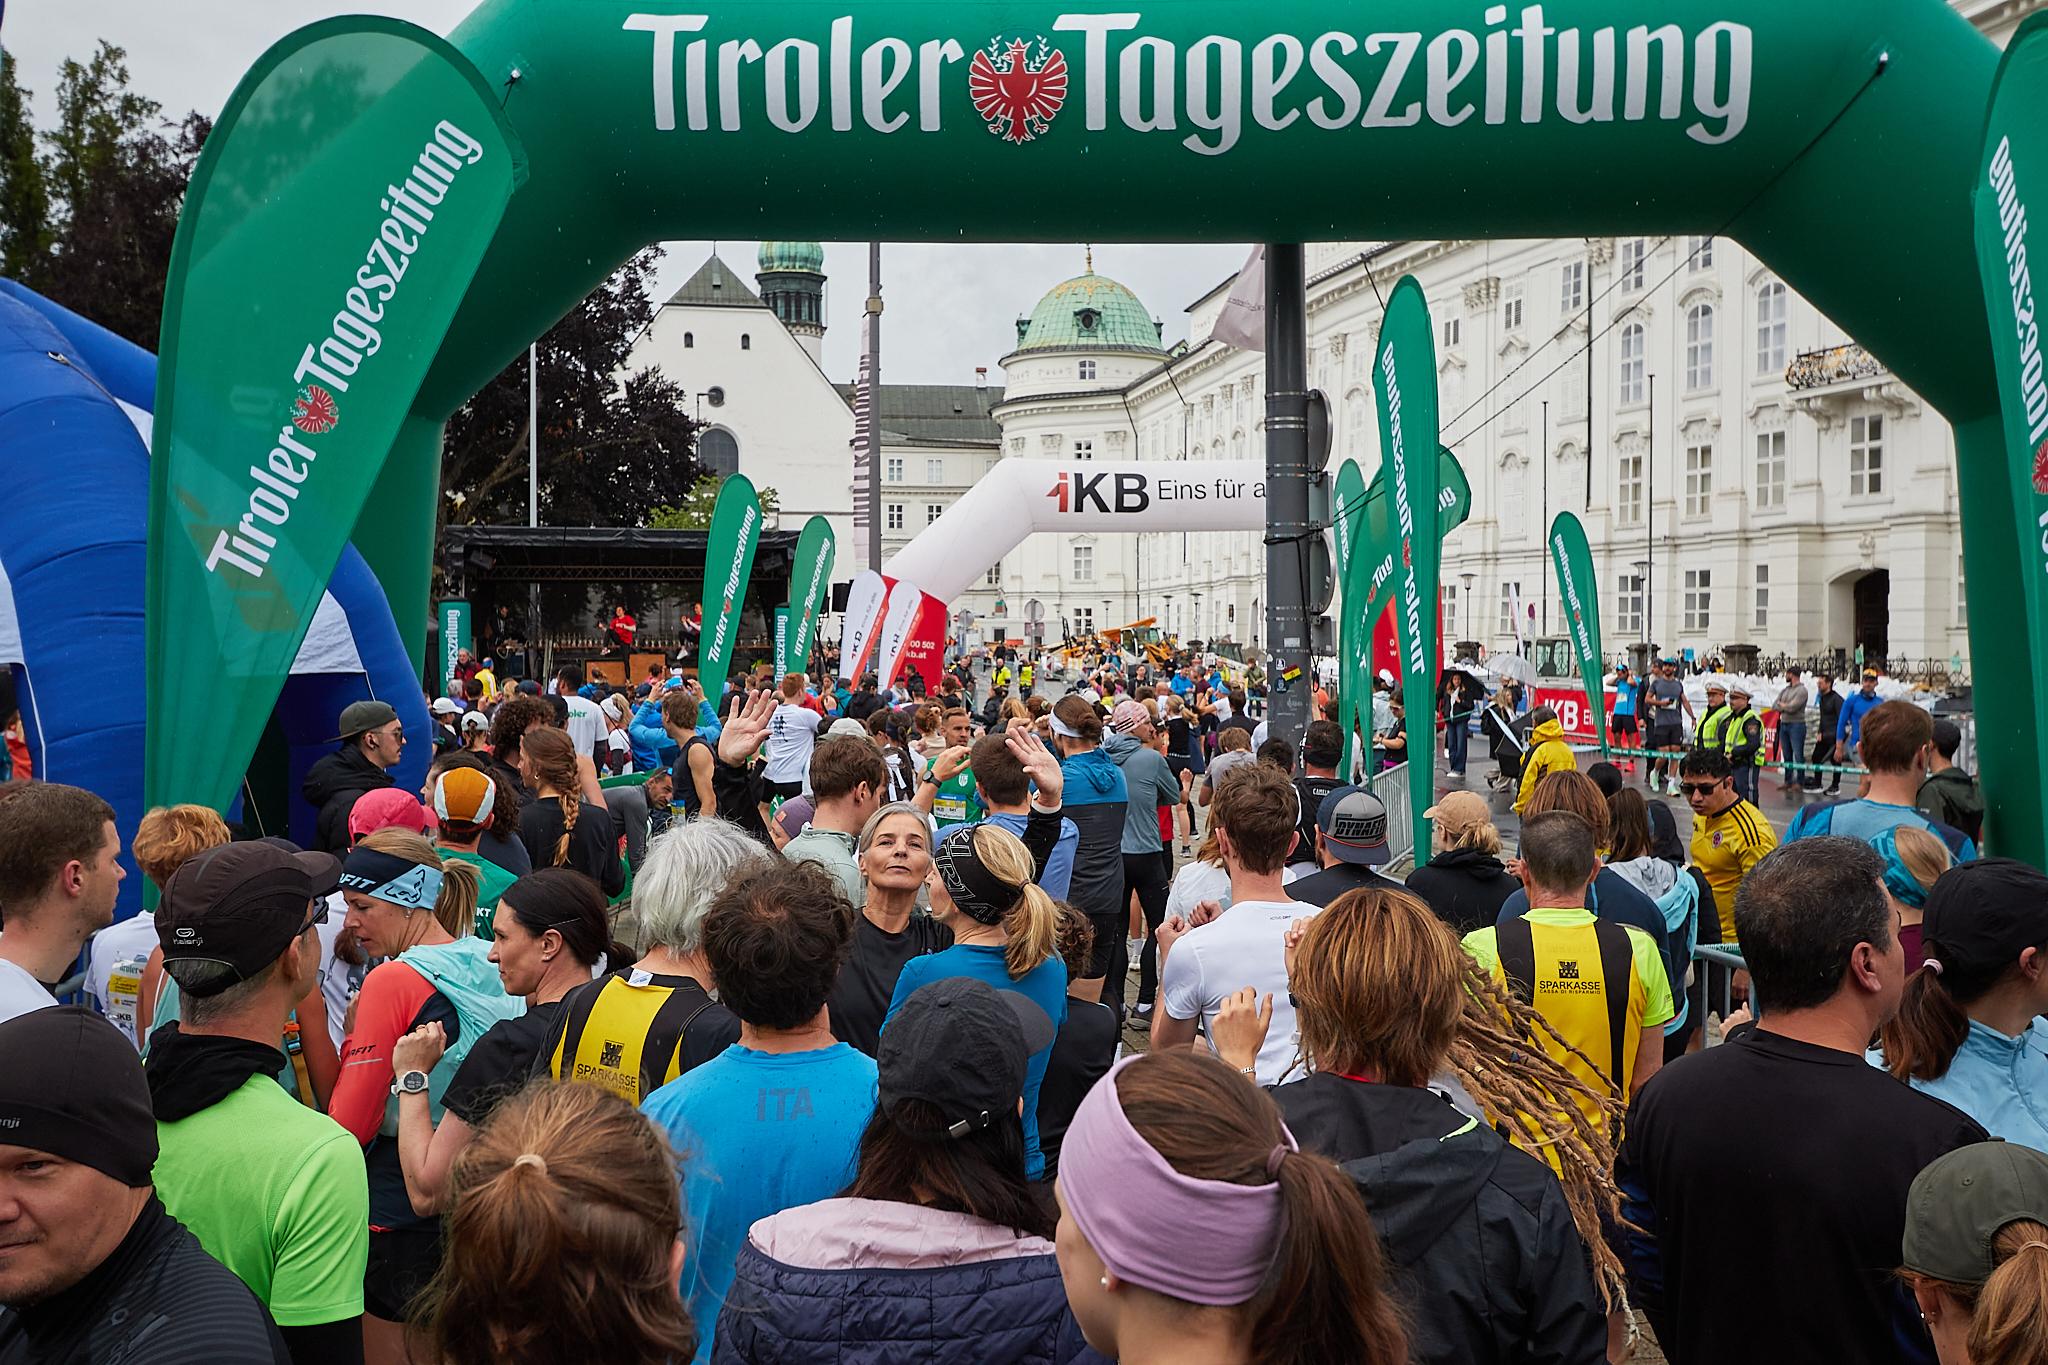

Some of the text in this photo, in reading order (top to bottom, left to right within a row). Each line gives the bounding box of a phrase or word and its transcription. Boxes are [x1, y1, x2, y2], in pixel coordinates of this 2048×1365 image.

[622, 3, 1753, 156] Tiroler Tageszeitung
[206, 120, 484, 577] Tiroler Tageszeitung
[1158, 480, 1207, 500] Eins
[1214, 479, 1245, 499] für
[707, 505, 757, 663] Tiroler Tageszeitung
[804, 537, 831, 610] Tageszeitung
[567, 708, 588, 719] oler
[1539, 980, 1600, 990] SPARKASSE
[576, 1063, 637, 1089] SPARKASSE
[757, 1087, 816, 1121] ITA
